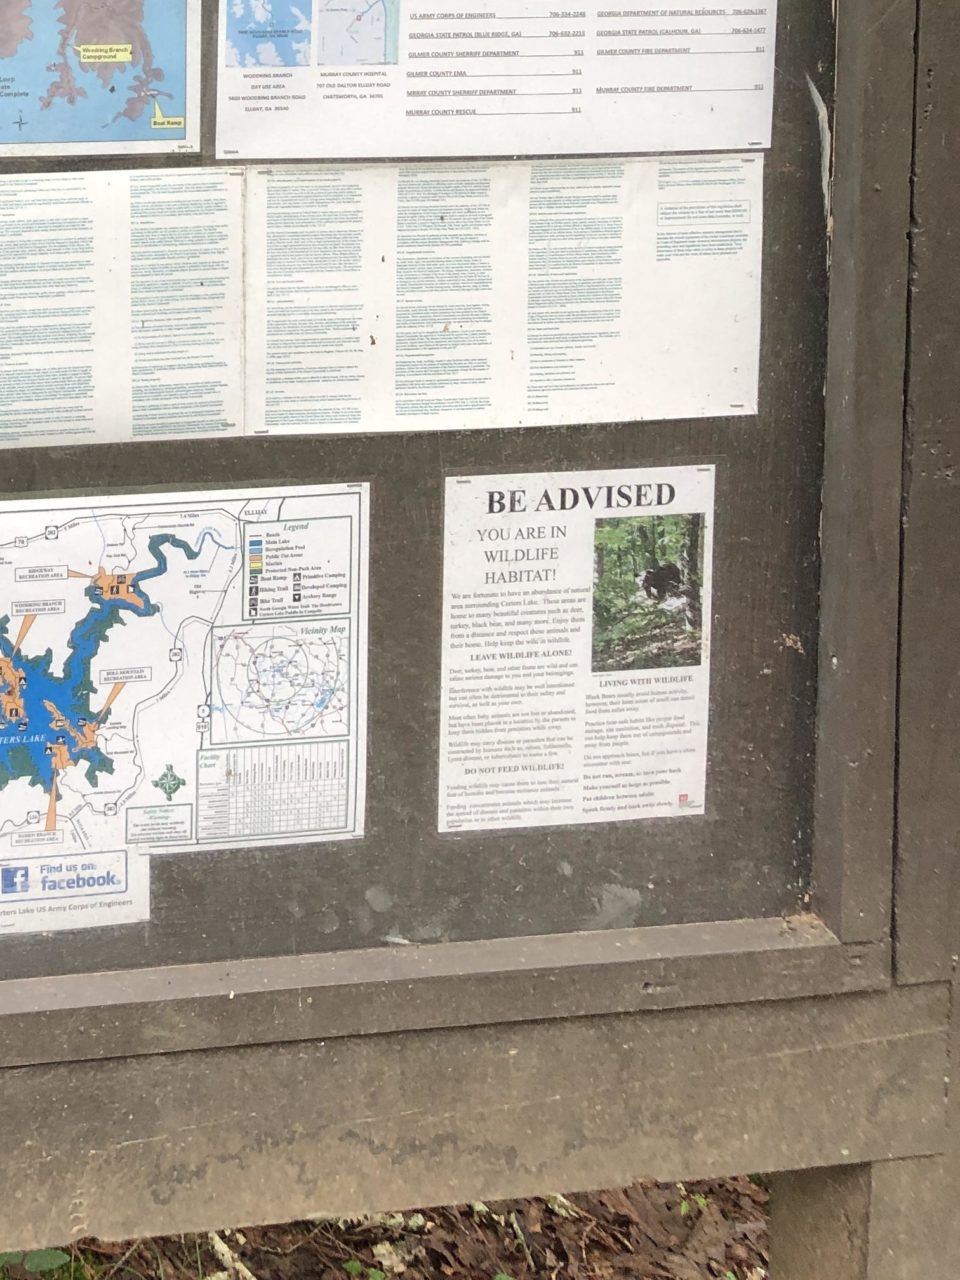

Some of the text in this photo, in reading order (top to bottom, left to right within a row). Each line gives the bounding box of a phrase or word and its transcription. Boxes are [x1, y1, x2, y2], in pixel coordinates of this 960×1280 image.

[487, 483, 676, 514] BE ADVISED
[283, 522, 309, 532] Legend
[477, 526, 567, 542] YOU ARE IN
[484, 547, 559, 563] WILDLIFE
[485, 569, 556, 584] HABITAT!
[301, 626, 346, 635] Vicinity Map
[470, 649, 572, 661] LEAVE WILDLIFE ALONE!
[599, 675, 693, 688] LIVING WITH WILDLIFE
[20, 734, 46, 743] LAKE
[498, 765, 519, 773] FEED
[522, 763, 565, 772] WILDLIFE!
[40, 863, 97, 874] Find us on:
[41, 871, 115, 891] facebook
[19, 907, 35, 915] Lake
[48, 905, 67, 913] Army
[69, 903, 89, 911] Corps
[99, 899, 132, 908] Engineers
